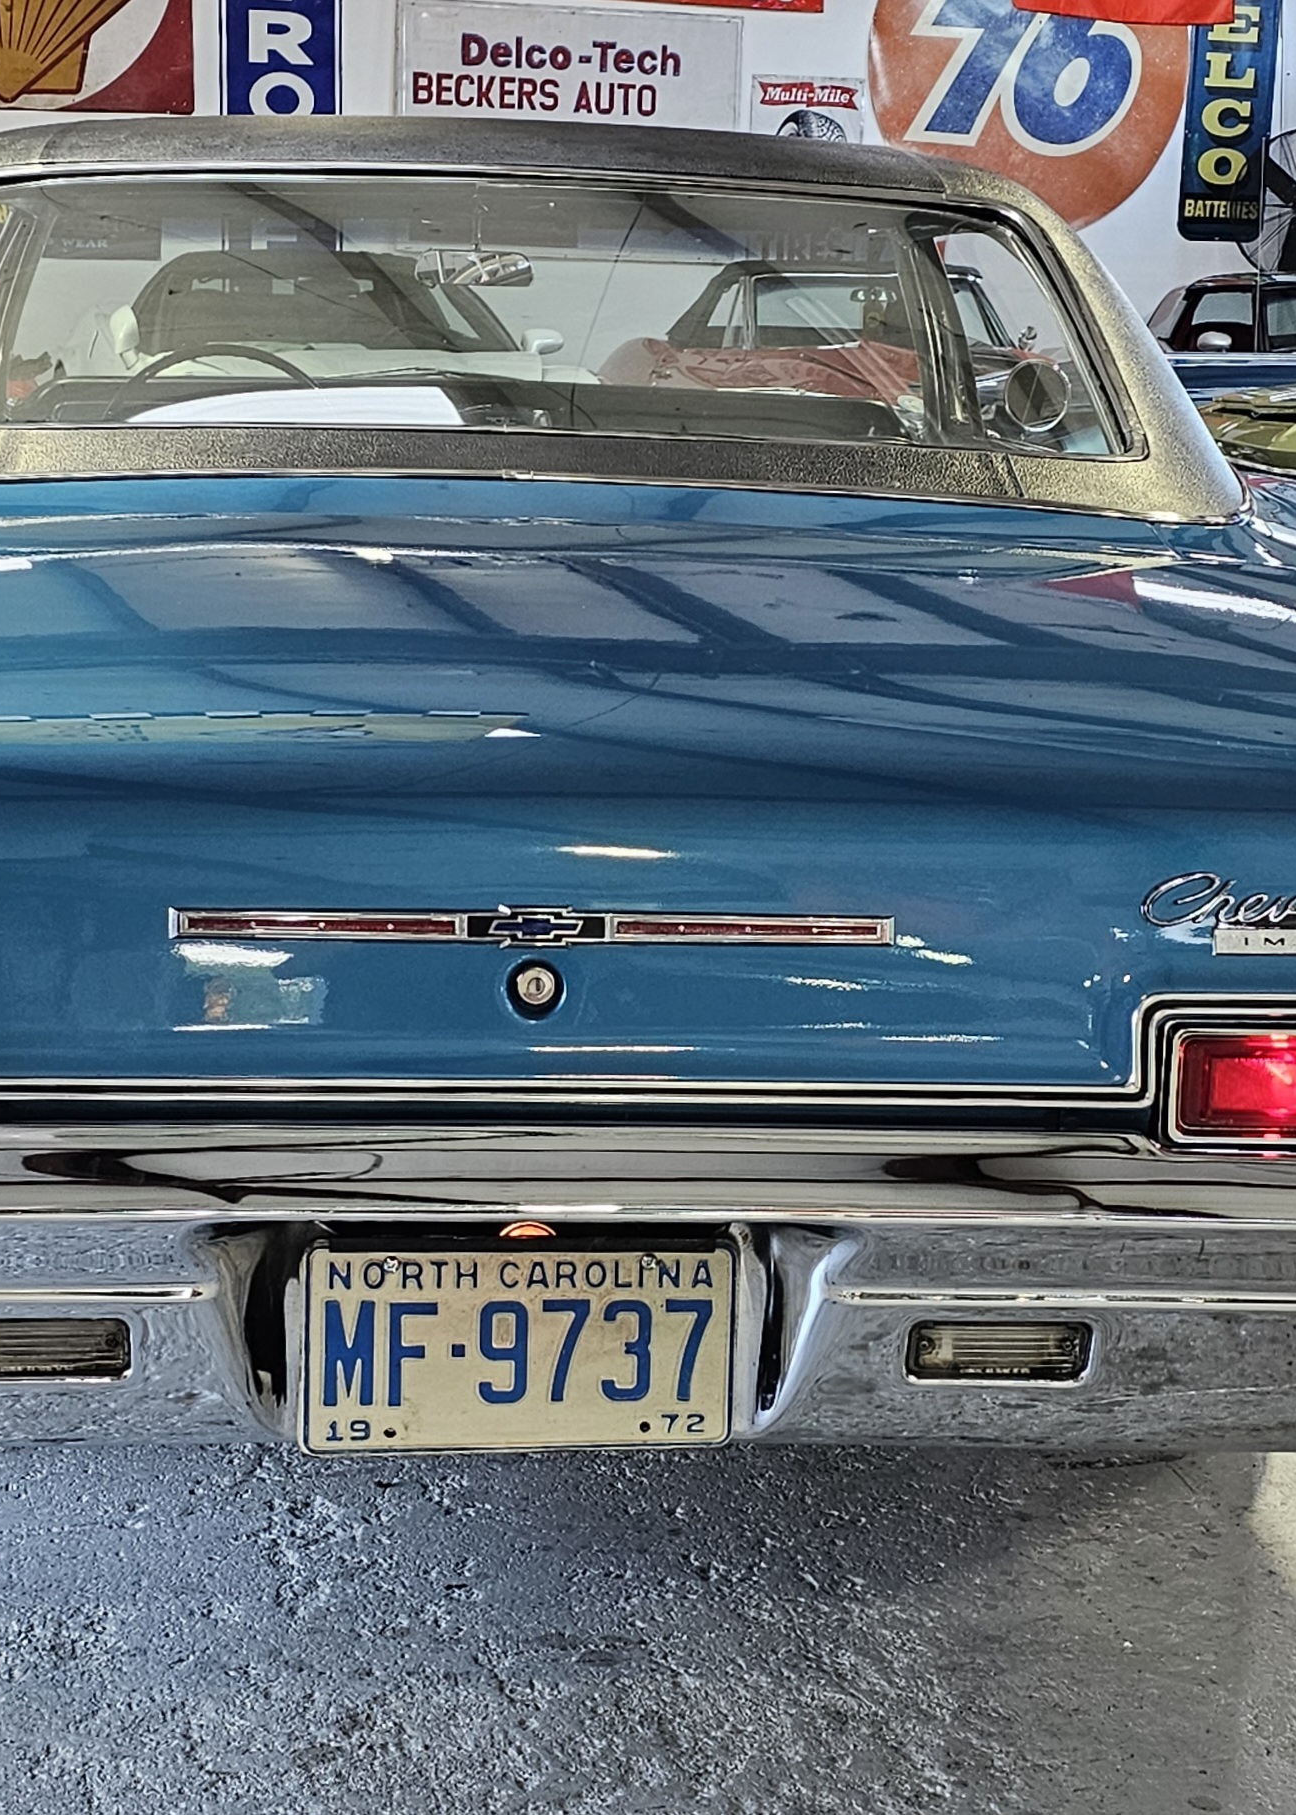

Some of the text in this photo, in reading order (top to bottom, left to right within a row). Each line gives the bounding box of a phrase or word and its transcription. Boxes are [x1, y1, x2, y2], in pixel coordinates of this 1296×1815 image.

[460, 33, 681, 76] Delco-Tech
[412, 71, 656, 117] BECKERS AUTO
[764, 87, 851, 104] Multi-Mile
[903, 0, 1142, 157] 76
[328, 1259, 713, 1290] NORTH CAROLINA
[326, 1413, 706, 1441] 19 72
